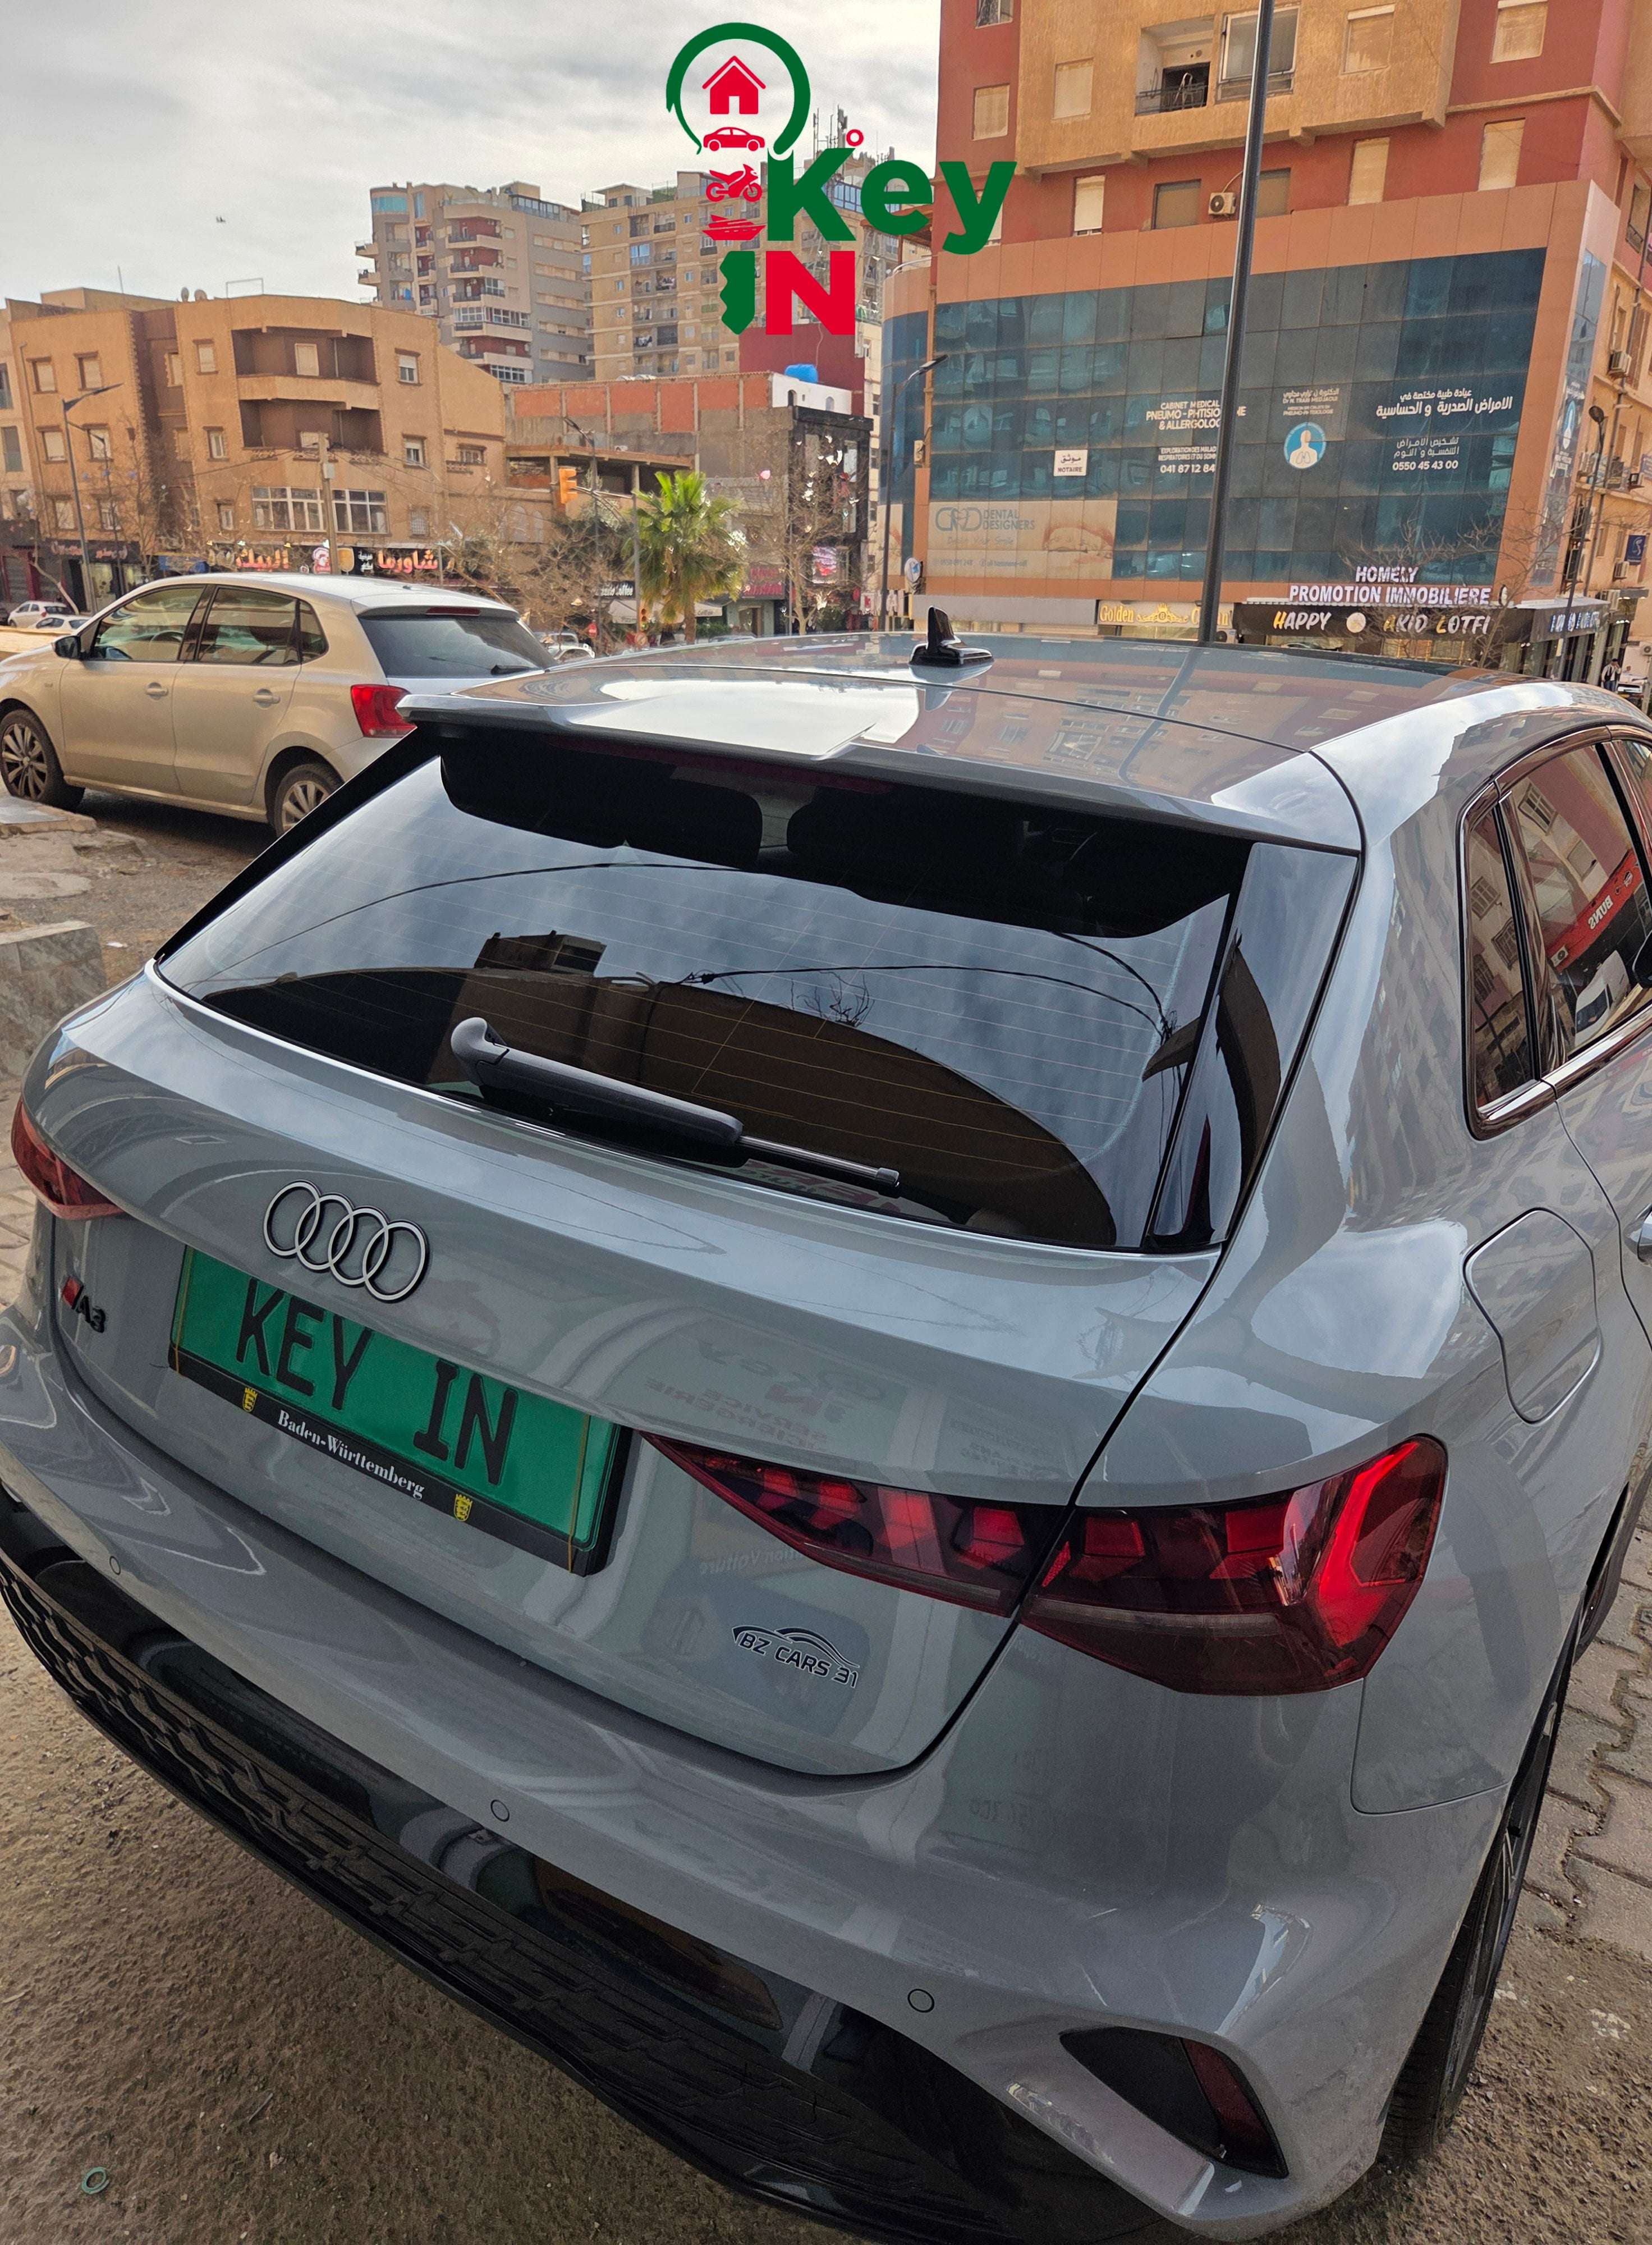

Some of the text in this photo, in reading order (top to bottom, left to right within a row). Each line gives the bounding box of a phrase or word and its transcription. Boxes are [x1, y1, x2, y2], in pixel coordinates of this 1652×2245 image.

[1400, 388, 1472, 402] عيادة طبية مختصة في
[1160, 400, 1220, 410] CABINET MEDICAL
[1376, 396, 1513, 419] الامراض الصدرية و الحساسية
[1146, 409, 1181, 420] PNEUMO
[1159, 421, 1165, 430] &
[1061, 454, 1081, 464] موثق
[1392, 460, 1458, 470] 0550 45 43 00
[1160, 465, 1176, 473] 041
[1178, 464, 1190, 473] 87
[1191, 464, 1201, 473] 12
[983, 509, 1020, 520] DENTAL
[982, 520, 1035, 530] DESIGNERS
[378, 549, 438, 574] شاورما
[1355, 566, 1419, 583] HOMELY
[1290, 585, 1381, 603] PROMOTION
[1100, 604, 1134, 622] Golden
[1273, 611, 1332, 631] HAPPY
[1436, 615, 1490, 634] LOTFI
[75, 1295, 106, 1334] A3
[236, 1278, 517, 1486] KEY IN
[278, 1410, 425, 1501] Baden-Württemberg
[737, 1632, 859, 1689] BZ CARS 31
